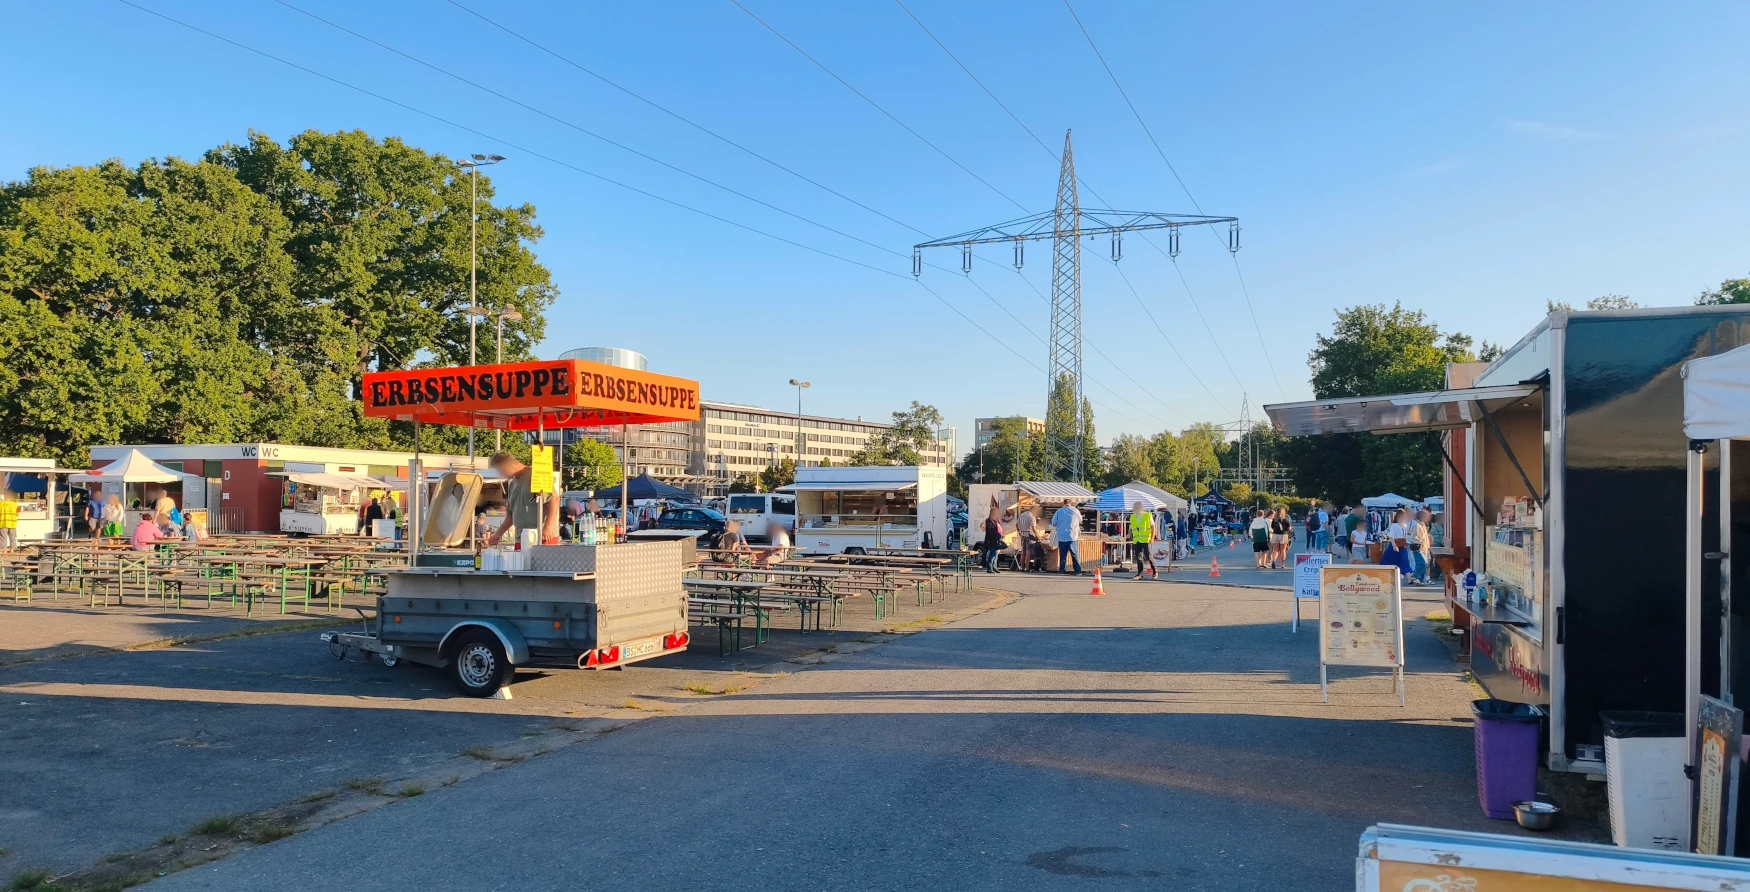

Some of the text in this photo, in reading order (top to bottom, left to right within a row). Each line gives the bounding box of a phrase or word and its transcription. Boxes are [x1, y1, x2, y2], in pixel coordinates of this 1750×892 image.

[371, 367, 569, 407] ERBSENSUPPE
[580, 371, 696, 411] ERBSENSUPPE
[241, 447, 257, 457] WC
[262, 447, 279, 457] WC
[224, 470, 231, 480] D
[1337, 584, 1381, 594] Bollywood
